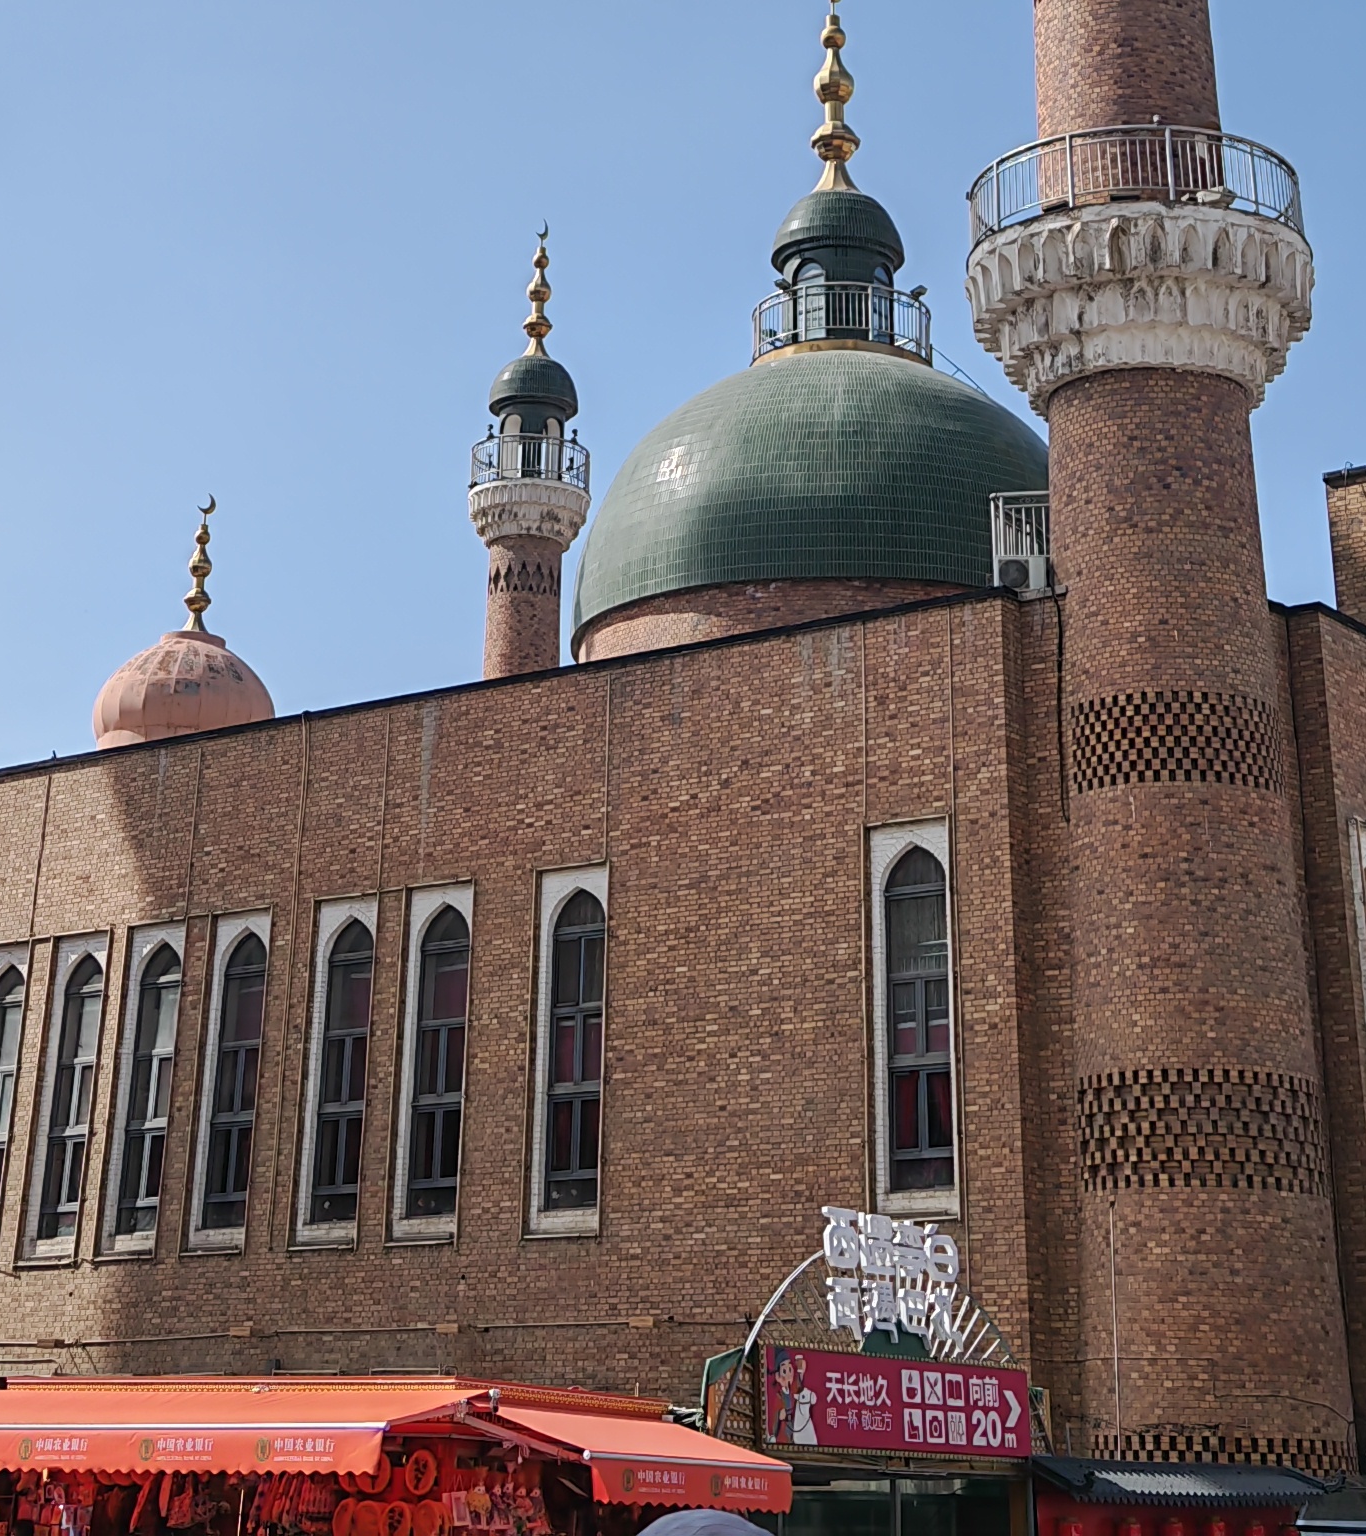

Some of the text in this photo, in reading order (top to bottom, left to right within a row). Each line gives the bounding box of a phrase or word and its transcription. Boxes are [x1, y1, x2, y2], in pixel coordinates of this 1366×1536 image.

[825, 1371, 892, 1407] 天长地久
[969, 1374, 1000, 1408] 向前
[826, 1407, 893, 1432] 喝一杯 敬远方
[971, 1409, 1018, 1449] 20m
[35, 1438, 88, 1452] 中国农业银行
[157, 1437, 214, 1452] 中国农业银行
[274, 1437, 336, 1452] 中国农业银行
